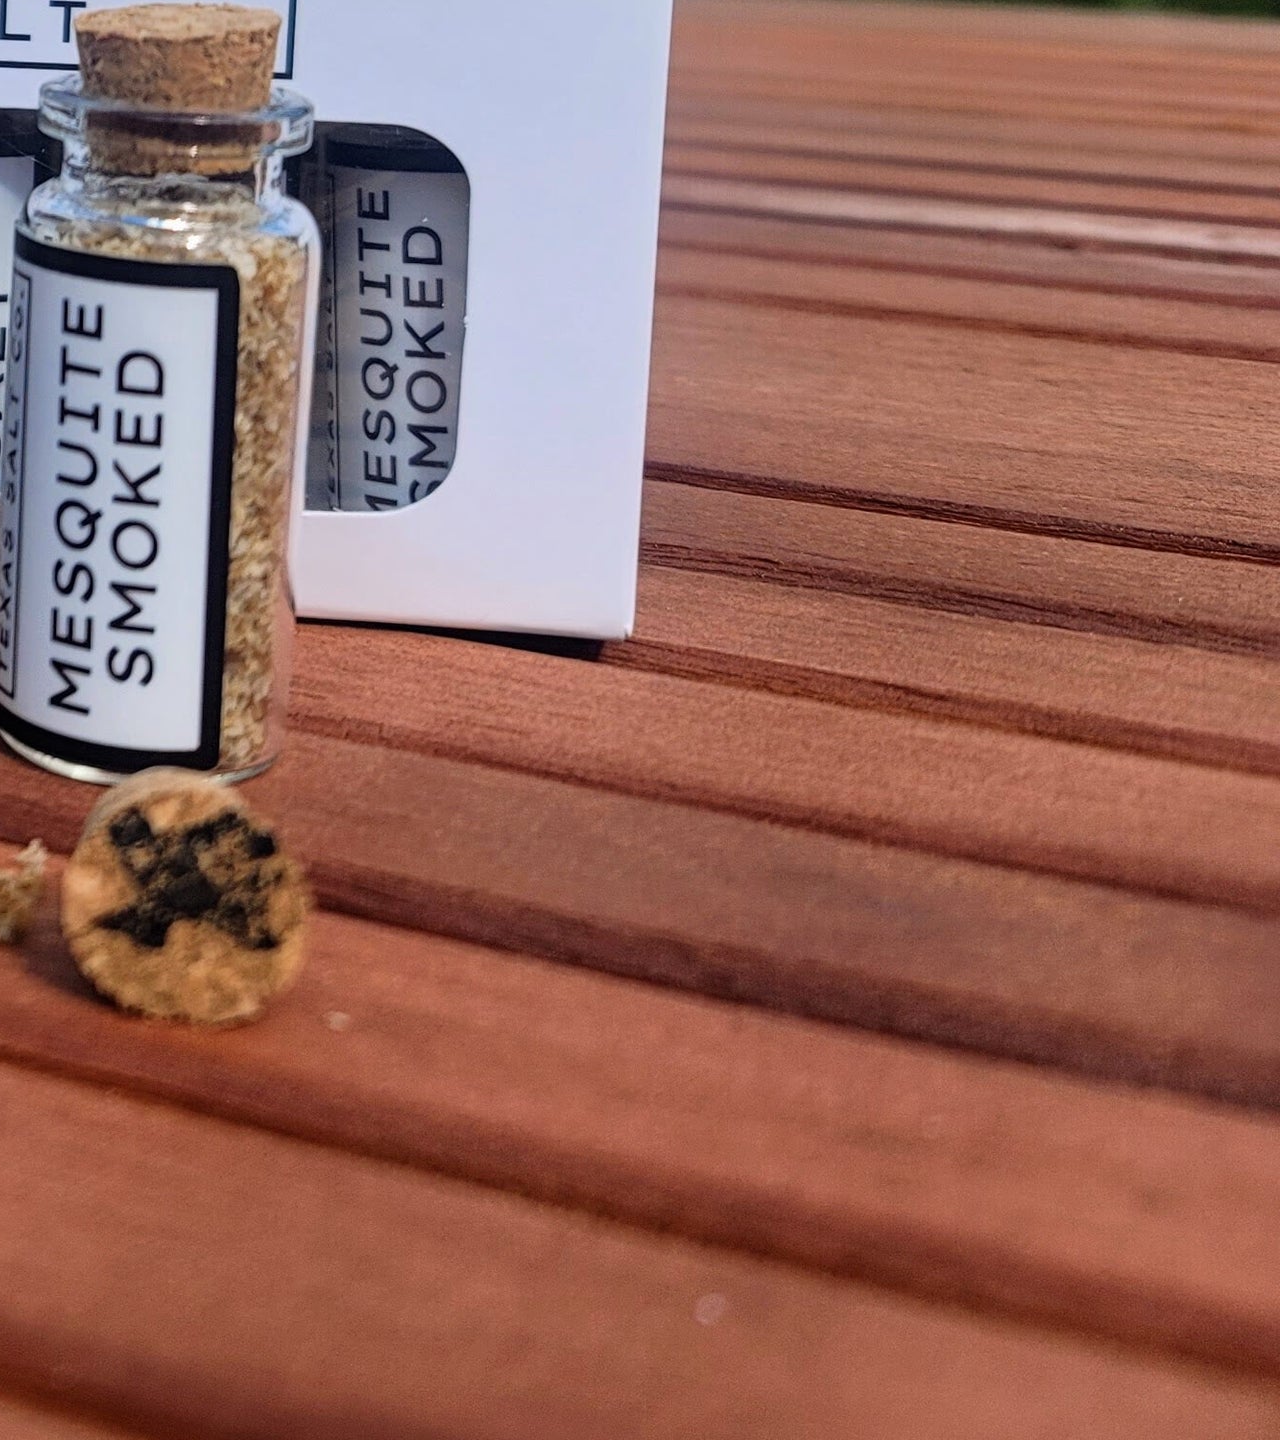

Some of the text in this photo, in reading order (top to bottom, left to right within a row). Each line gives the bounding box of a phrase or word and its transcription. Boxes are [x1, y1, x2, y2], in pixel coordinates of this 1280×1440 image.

[4, 392, 19, 504] SALT
[48, 297, 104, 716] MESQUITE
[107, 349, 166, 687] SMOKED
